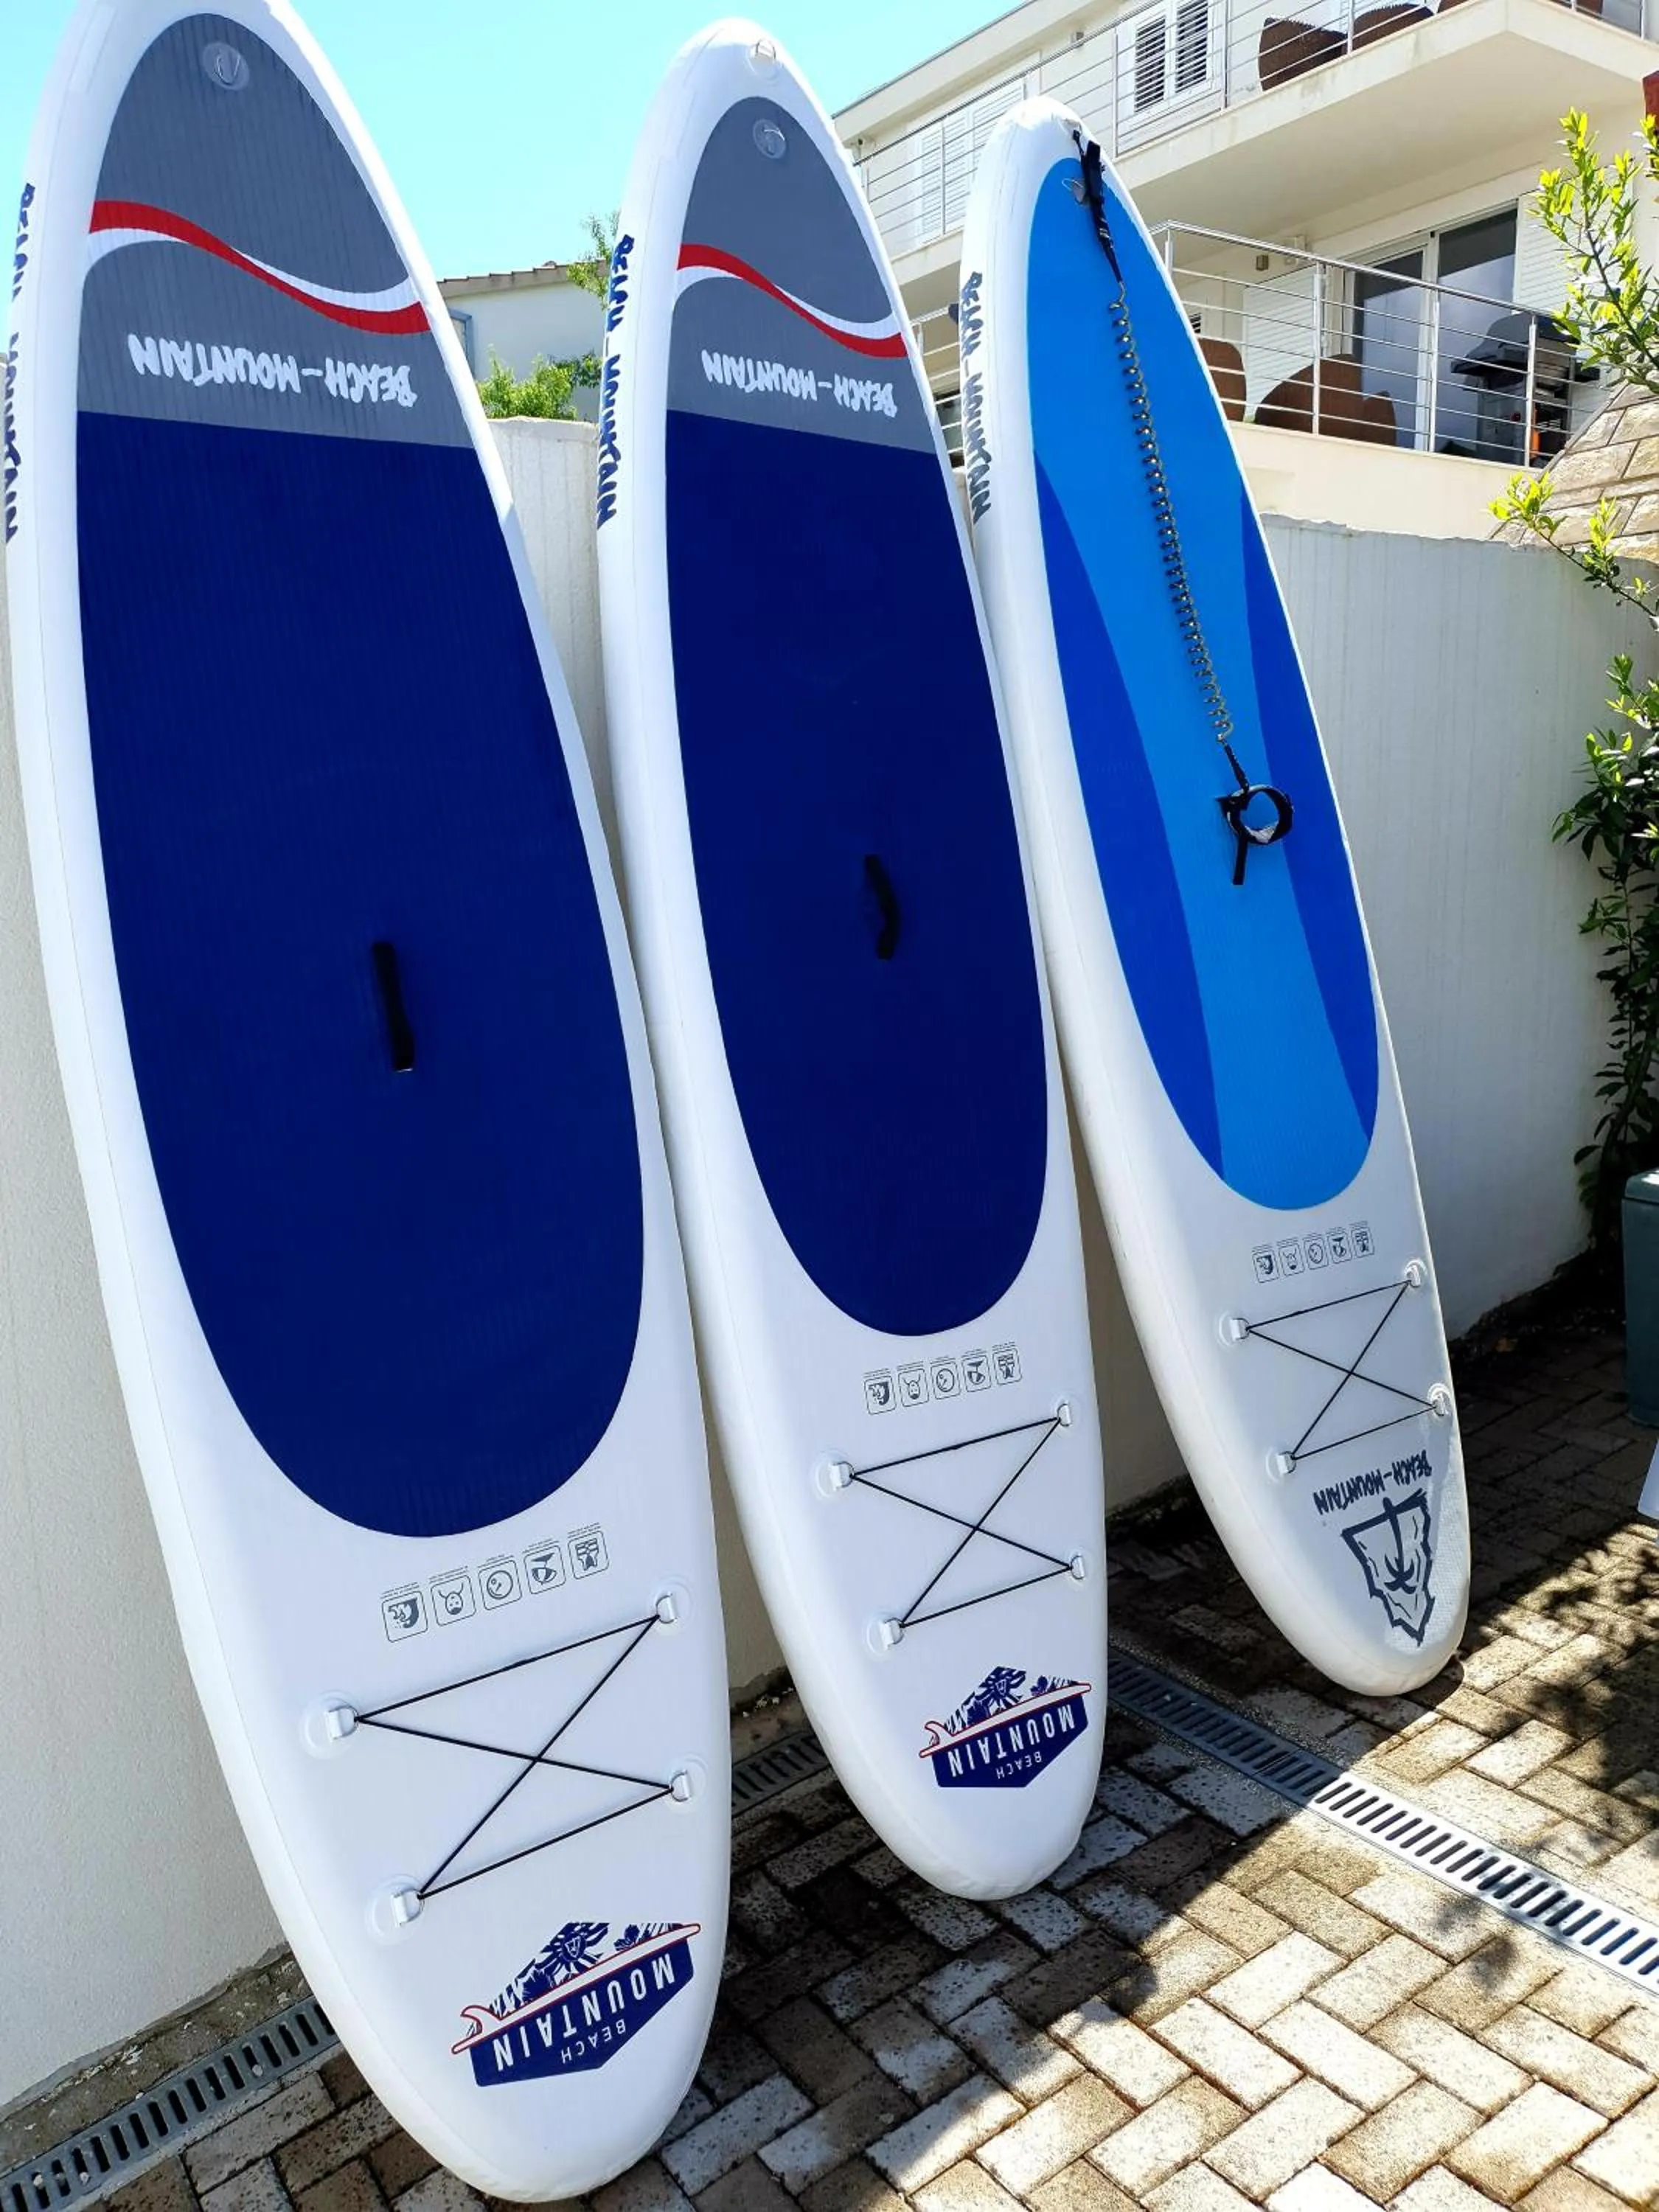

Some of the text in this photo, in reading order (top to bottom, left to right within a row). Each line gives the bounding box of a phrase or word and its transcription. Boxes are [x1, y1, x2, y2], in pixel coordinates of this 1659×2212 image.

[947, 1704, 1075, 1778] MOUNTAIN
[995, 1751, 1042, 1779] BEACH
[492, 1953, 676, 2071] MOUNTAIN
[560, 2018, 626, 2064] BEACH
